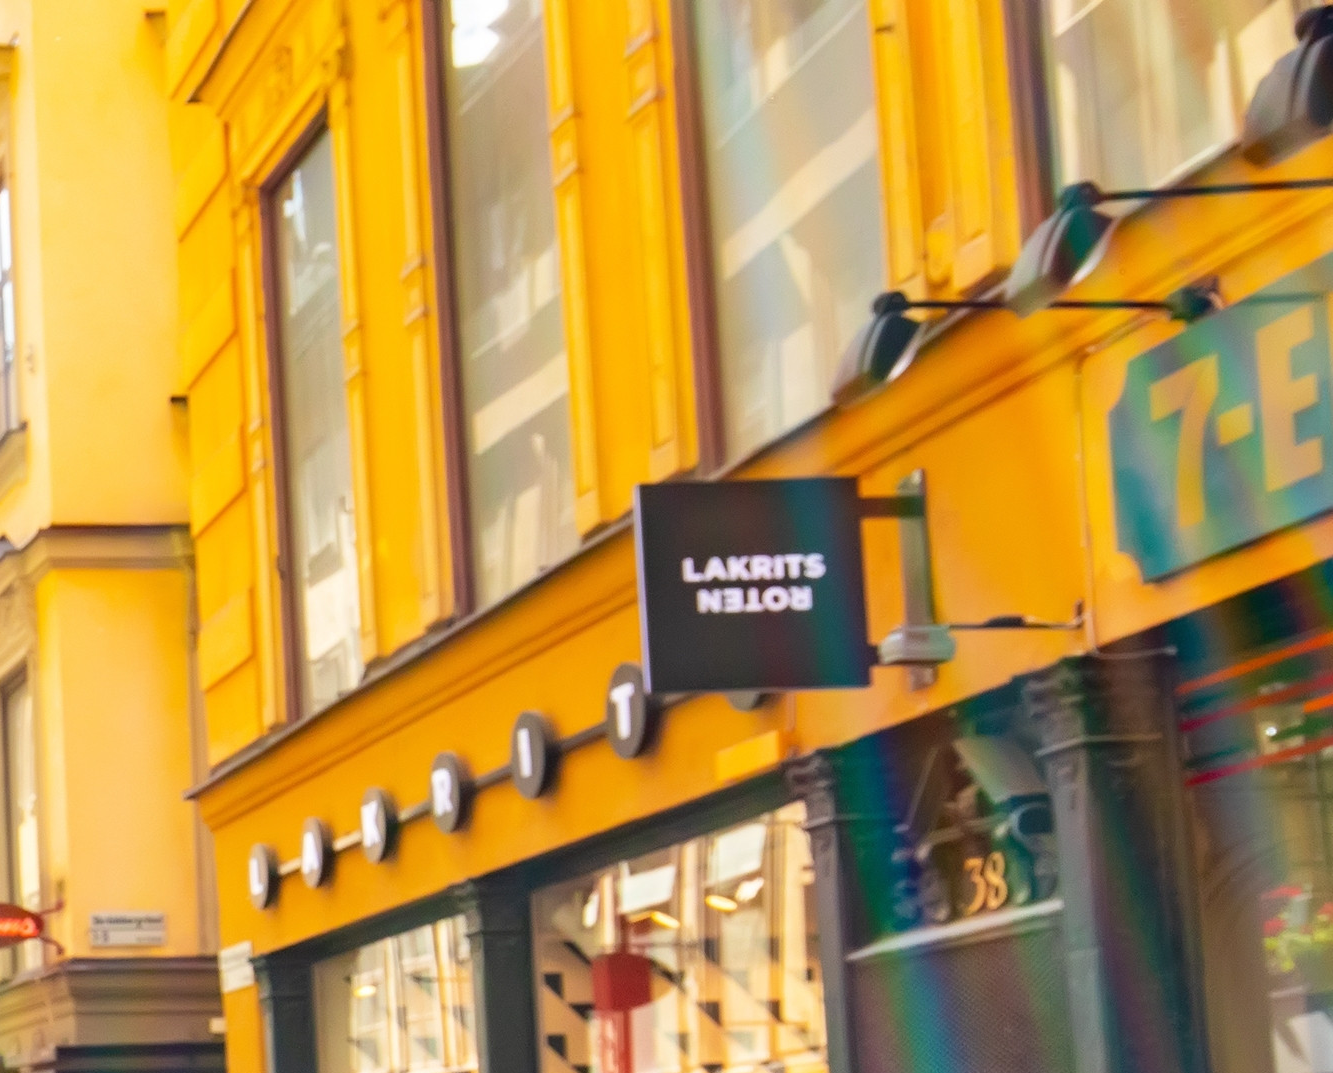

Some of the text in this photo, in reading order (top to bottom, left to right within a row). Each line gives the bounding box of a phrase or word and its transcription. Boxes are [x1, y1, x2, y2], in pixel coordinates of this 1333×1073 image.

[1149, 295, 1333, 528] 7-E
[681, 552, 827, 583] LAKRITS
[696, 585, 813, 614] ROTEN
[249, 681, 636, 896] LAKRIT
[963, 852, 1009, 917] 38
